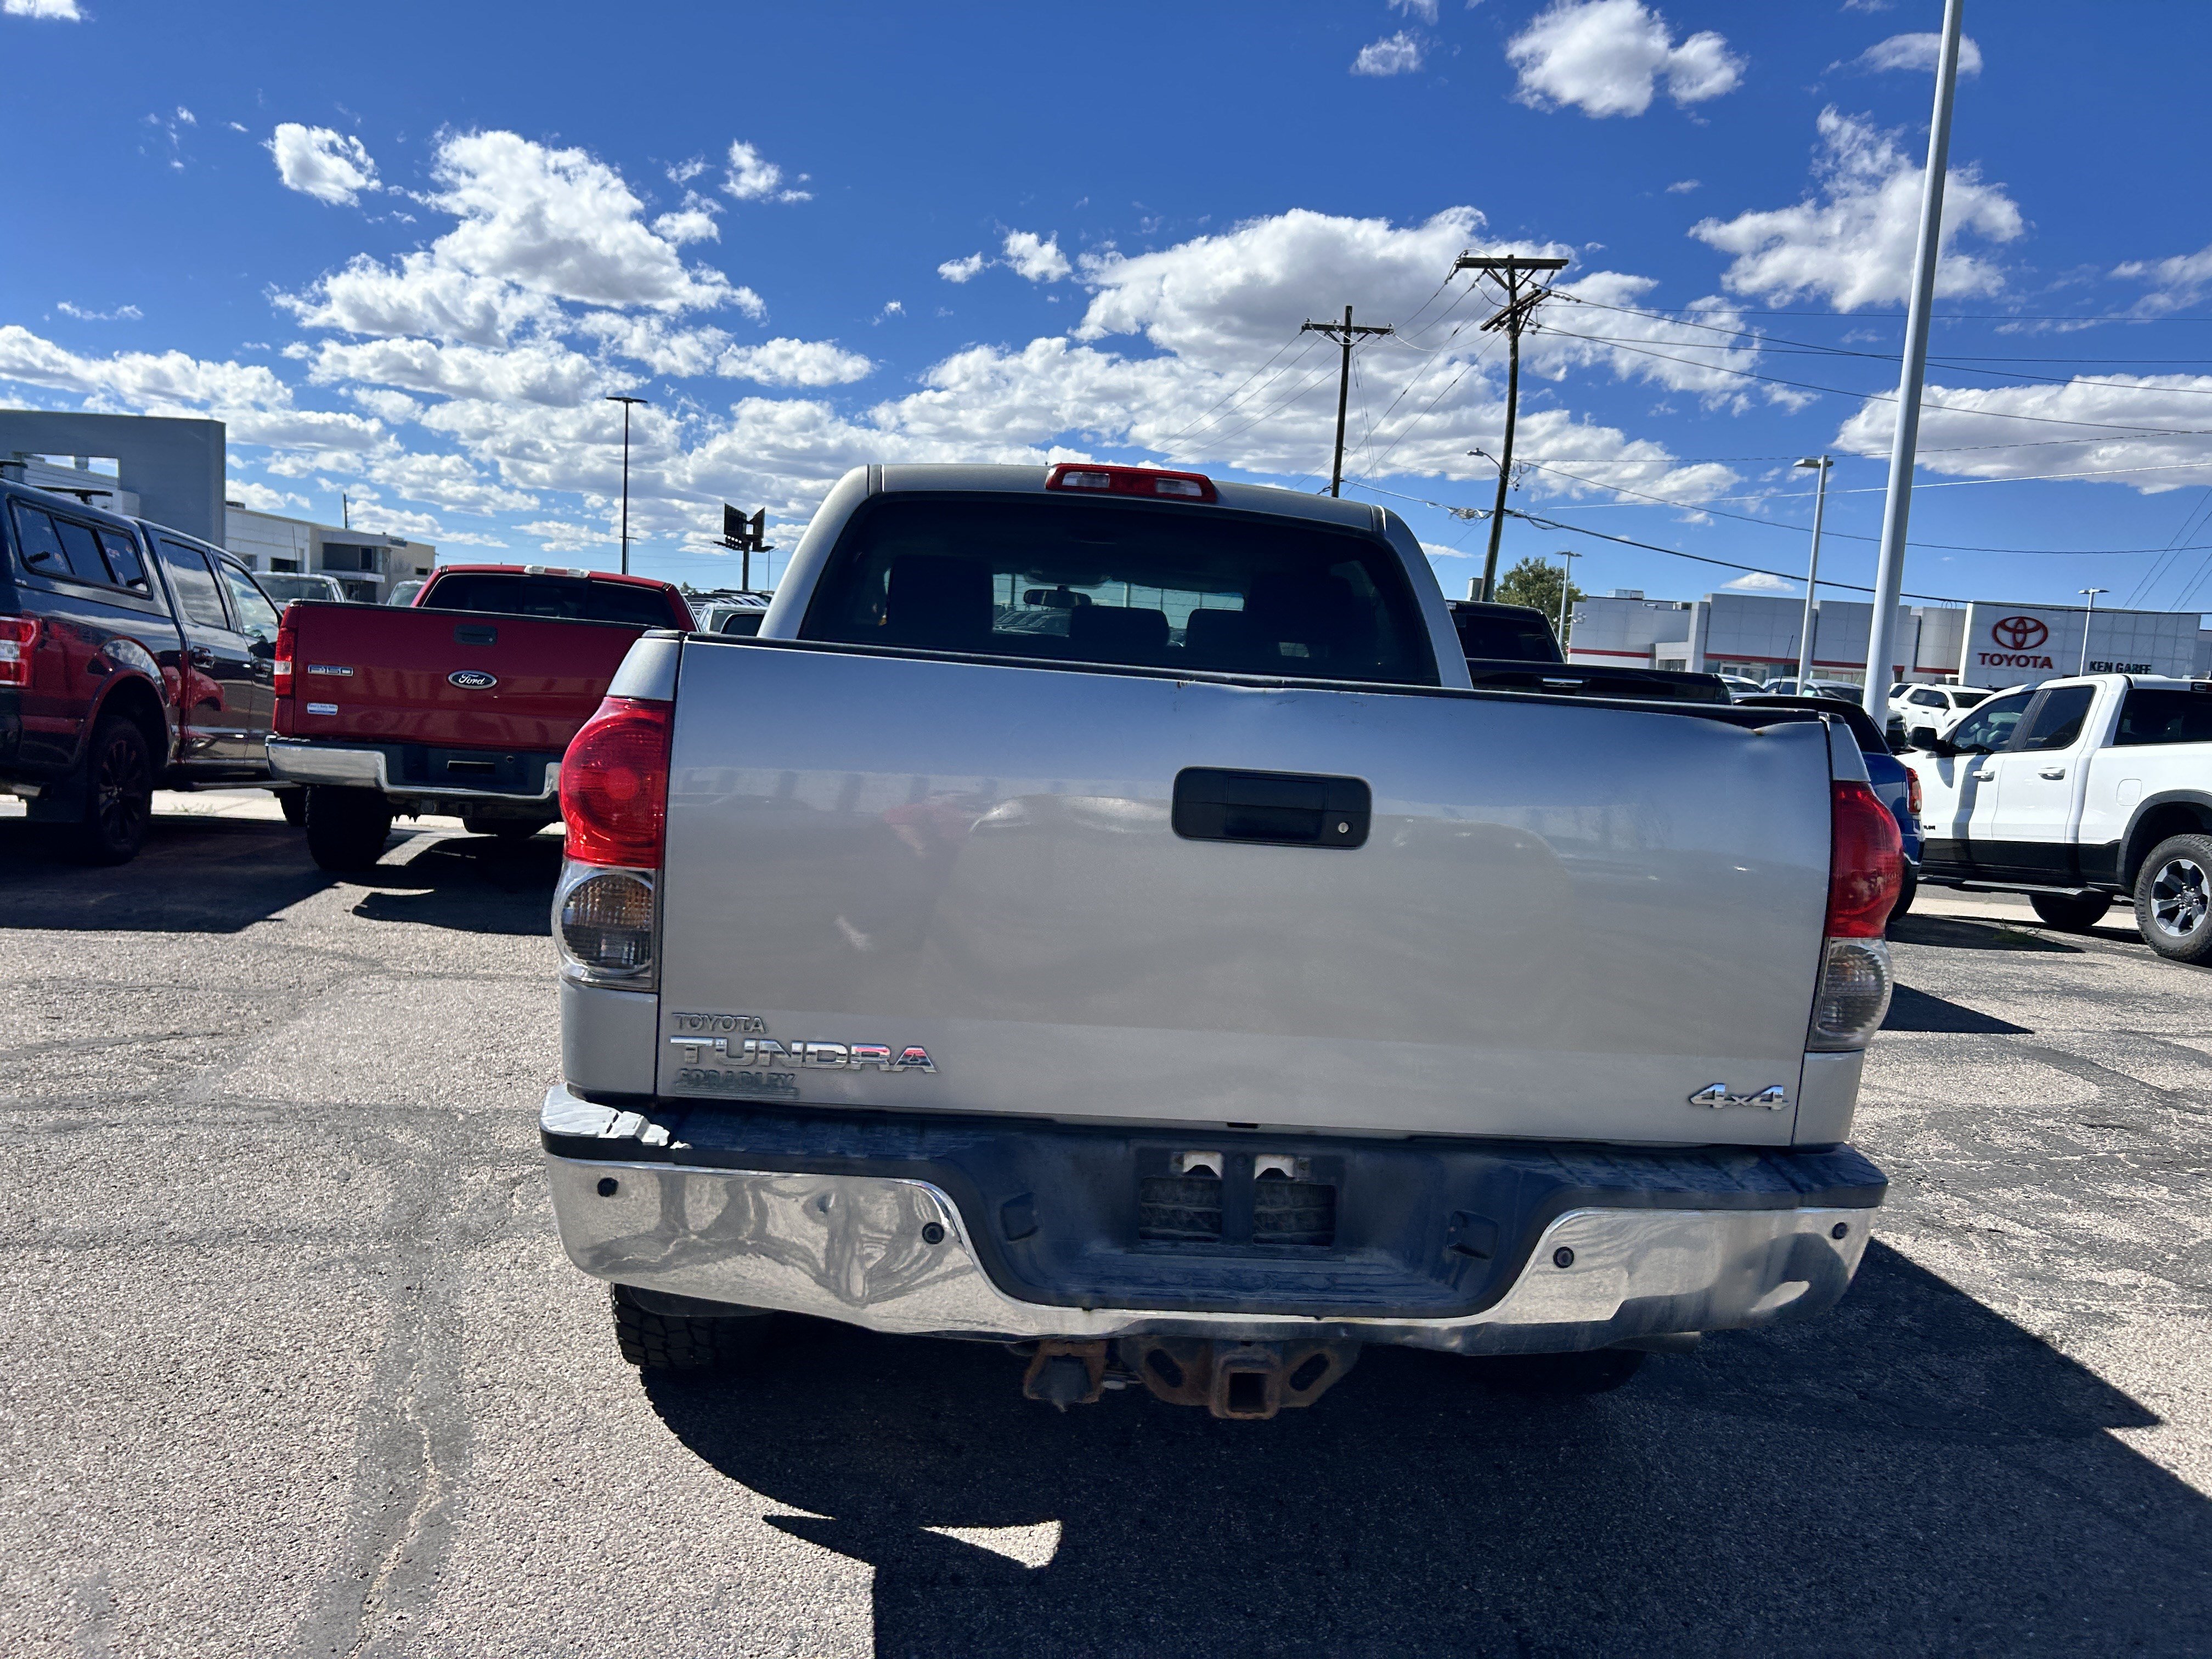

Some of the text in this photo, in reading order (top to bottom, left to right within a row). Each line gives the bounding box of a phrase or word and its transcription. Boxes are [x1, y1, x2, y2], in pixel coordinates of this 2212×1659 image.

[1977, 652, 2053, 669] TOYOTA
[2089, 661, 2113, 673] KEN
[459, 673, 486, 685] Ford
[672, 1012, 766, 1034] TOYOTA
[669, 1036, 939, 1074] TUNDRA
